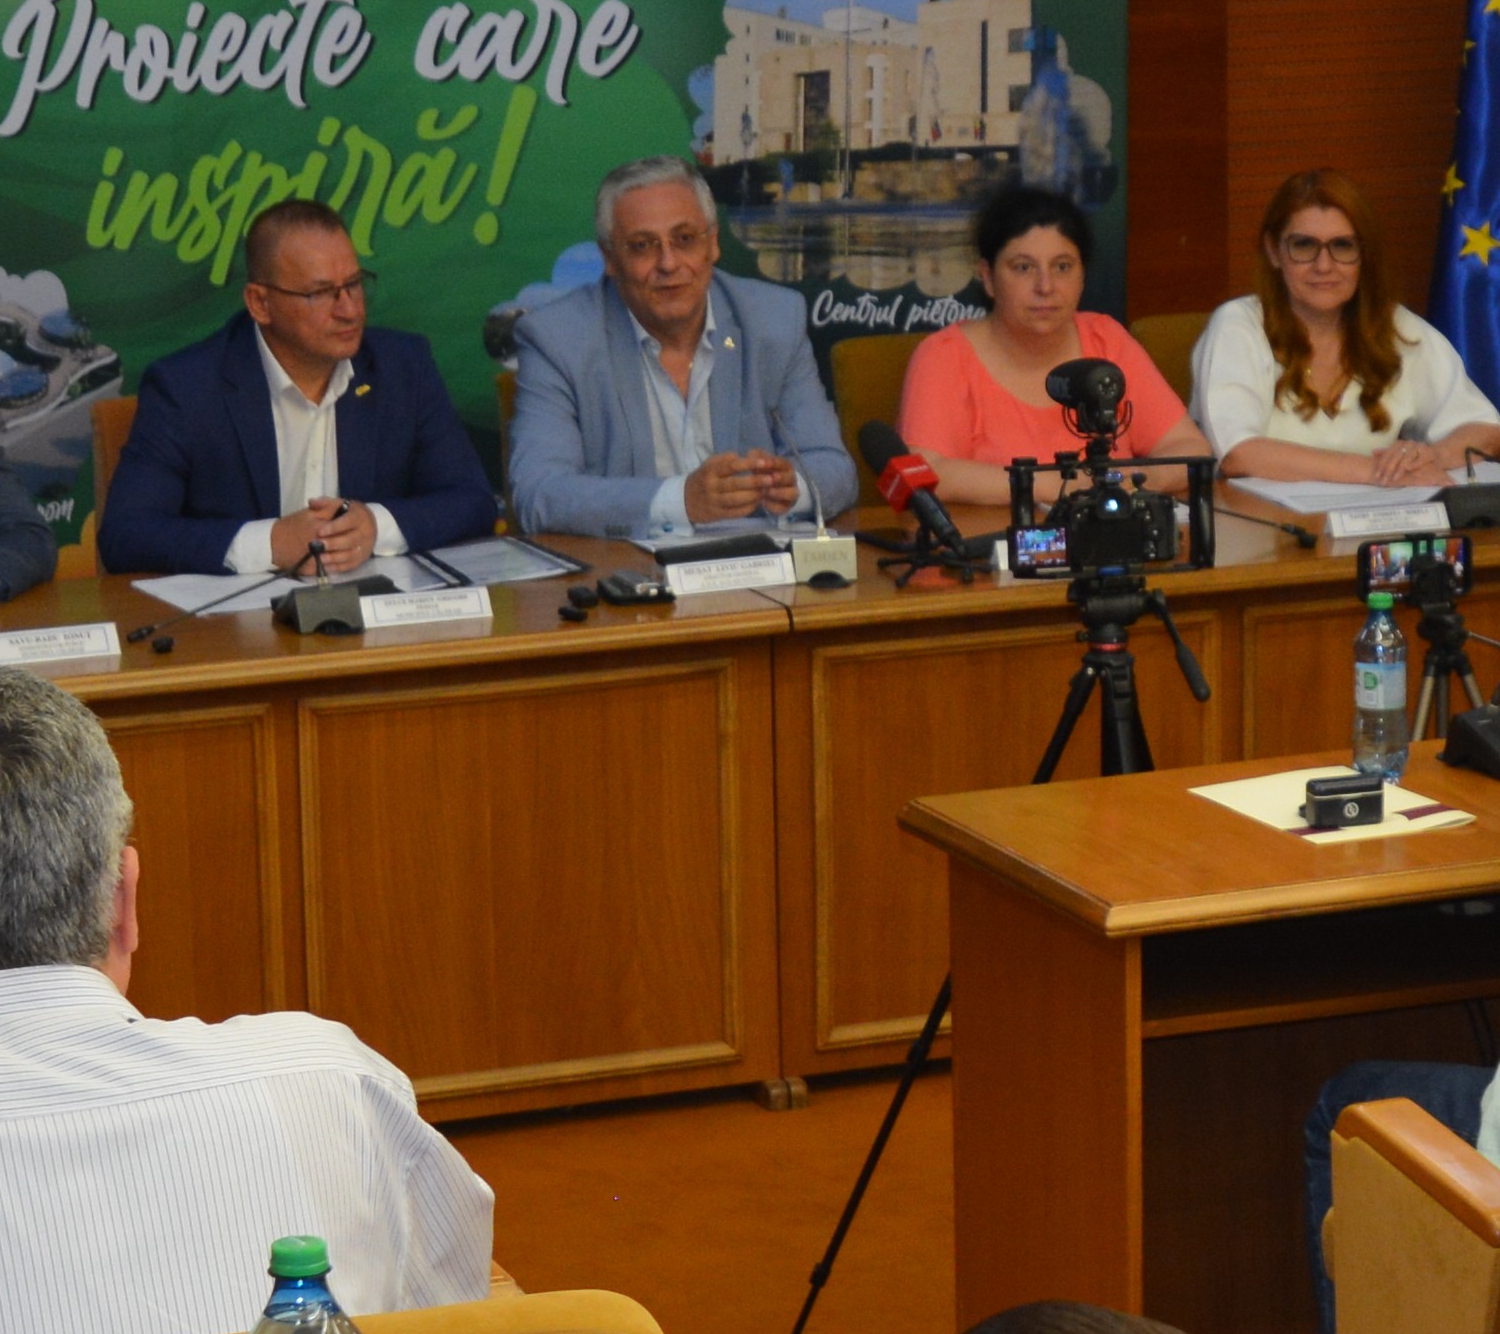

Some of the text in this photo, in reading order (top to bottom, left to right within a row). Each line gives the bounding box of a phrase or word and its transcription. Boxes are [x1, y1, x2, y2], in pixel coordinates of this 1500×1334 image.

[86, 85, 537, 286] inspiră!
[812, 289, 987, 331] Centrul pietona
